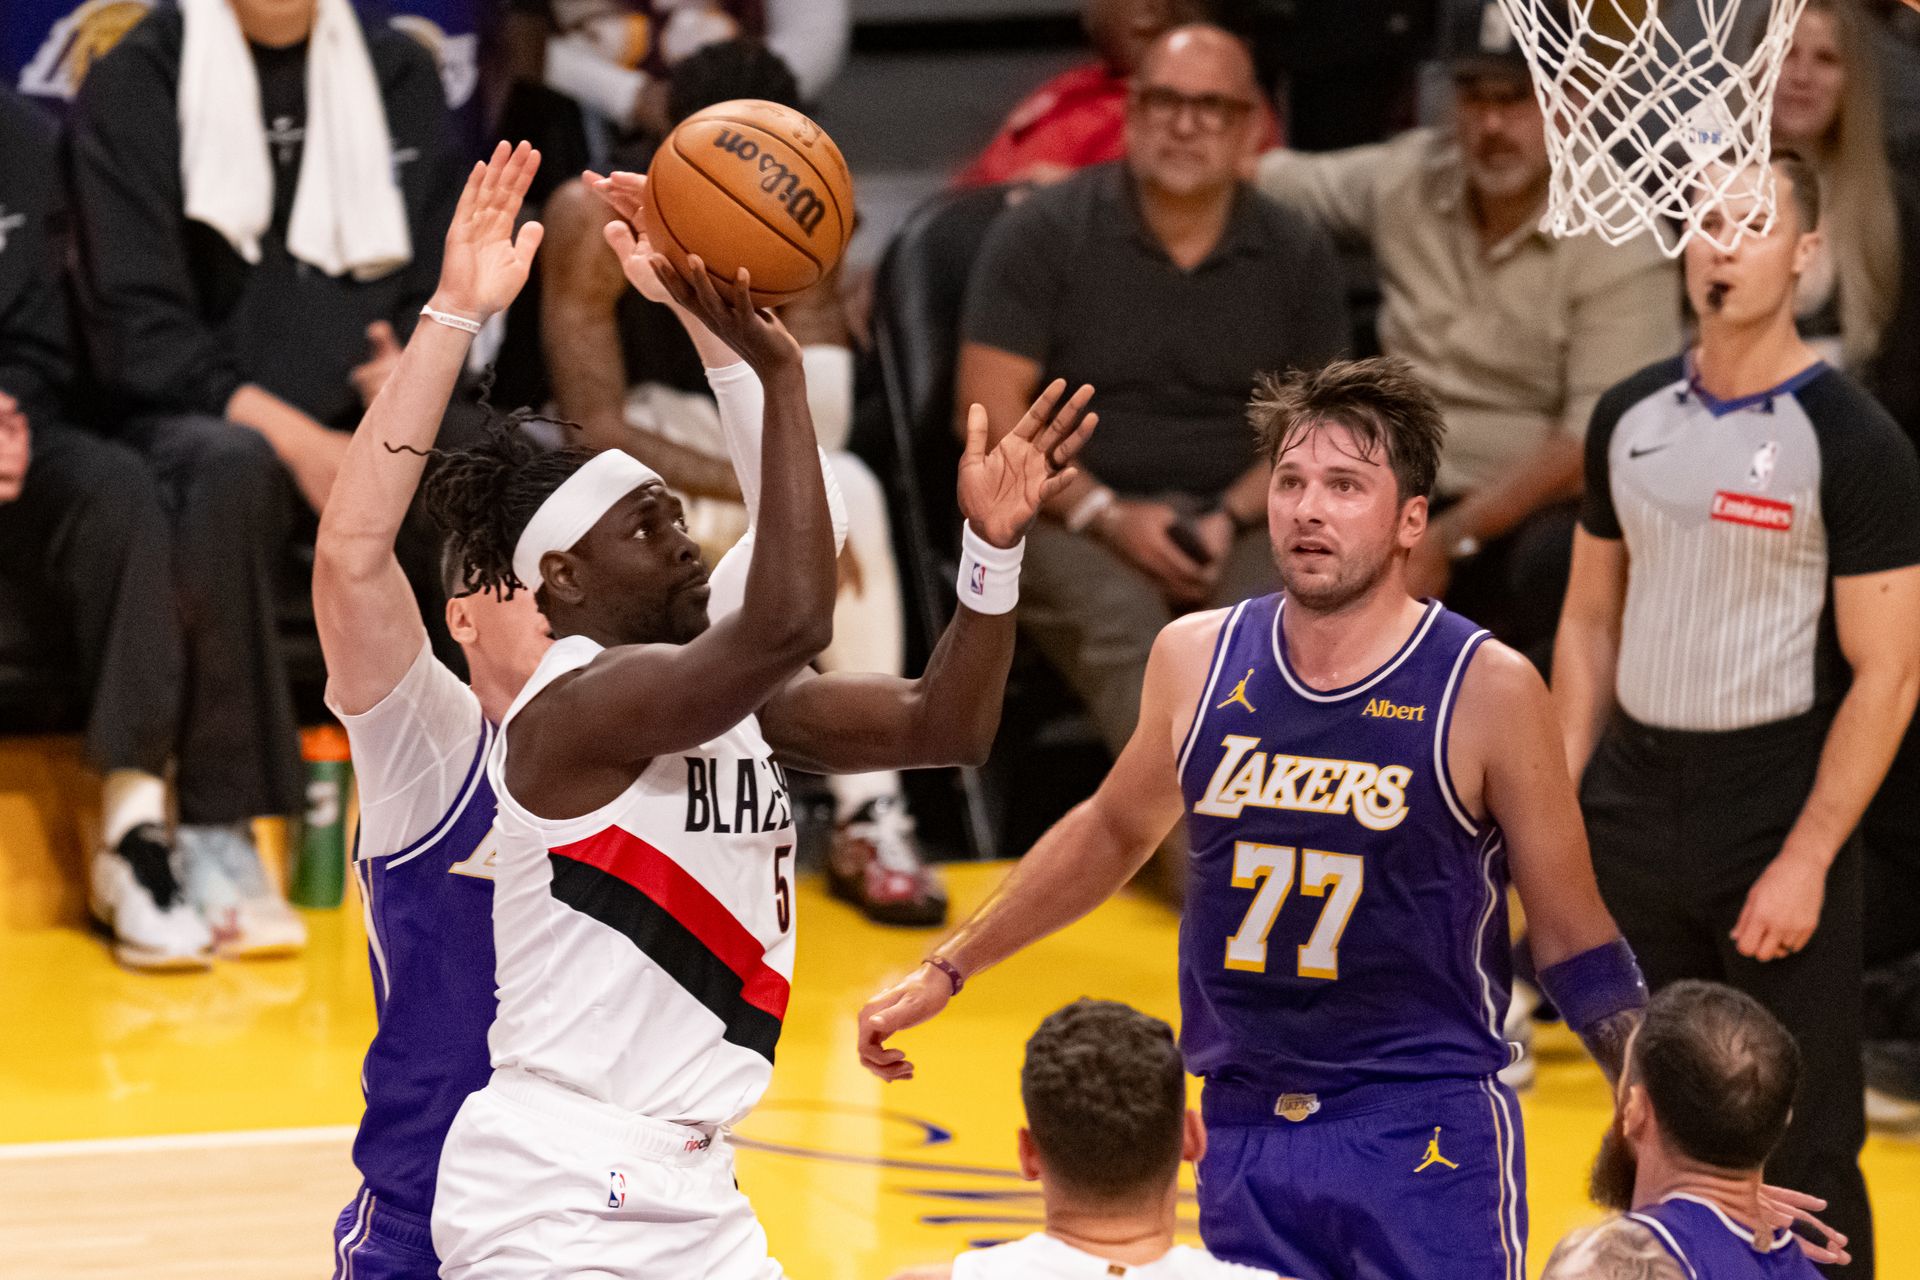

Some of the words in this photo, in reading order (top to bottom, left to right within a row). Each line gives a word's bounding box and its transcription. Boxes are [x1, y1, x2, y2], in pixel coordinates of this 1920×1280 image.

[714, 129, 825, 238] Wilson
[1713, 496, 1789, 524] Emirates
[1361, 698, 1426, 721] Albert
[1194, 734, 1413, 830] LAKERS
[774, 844, 792, 934] 5
[1224, 841, 1364, 981] 77
